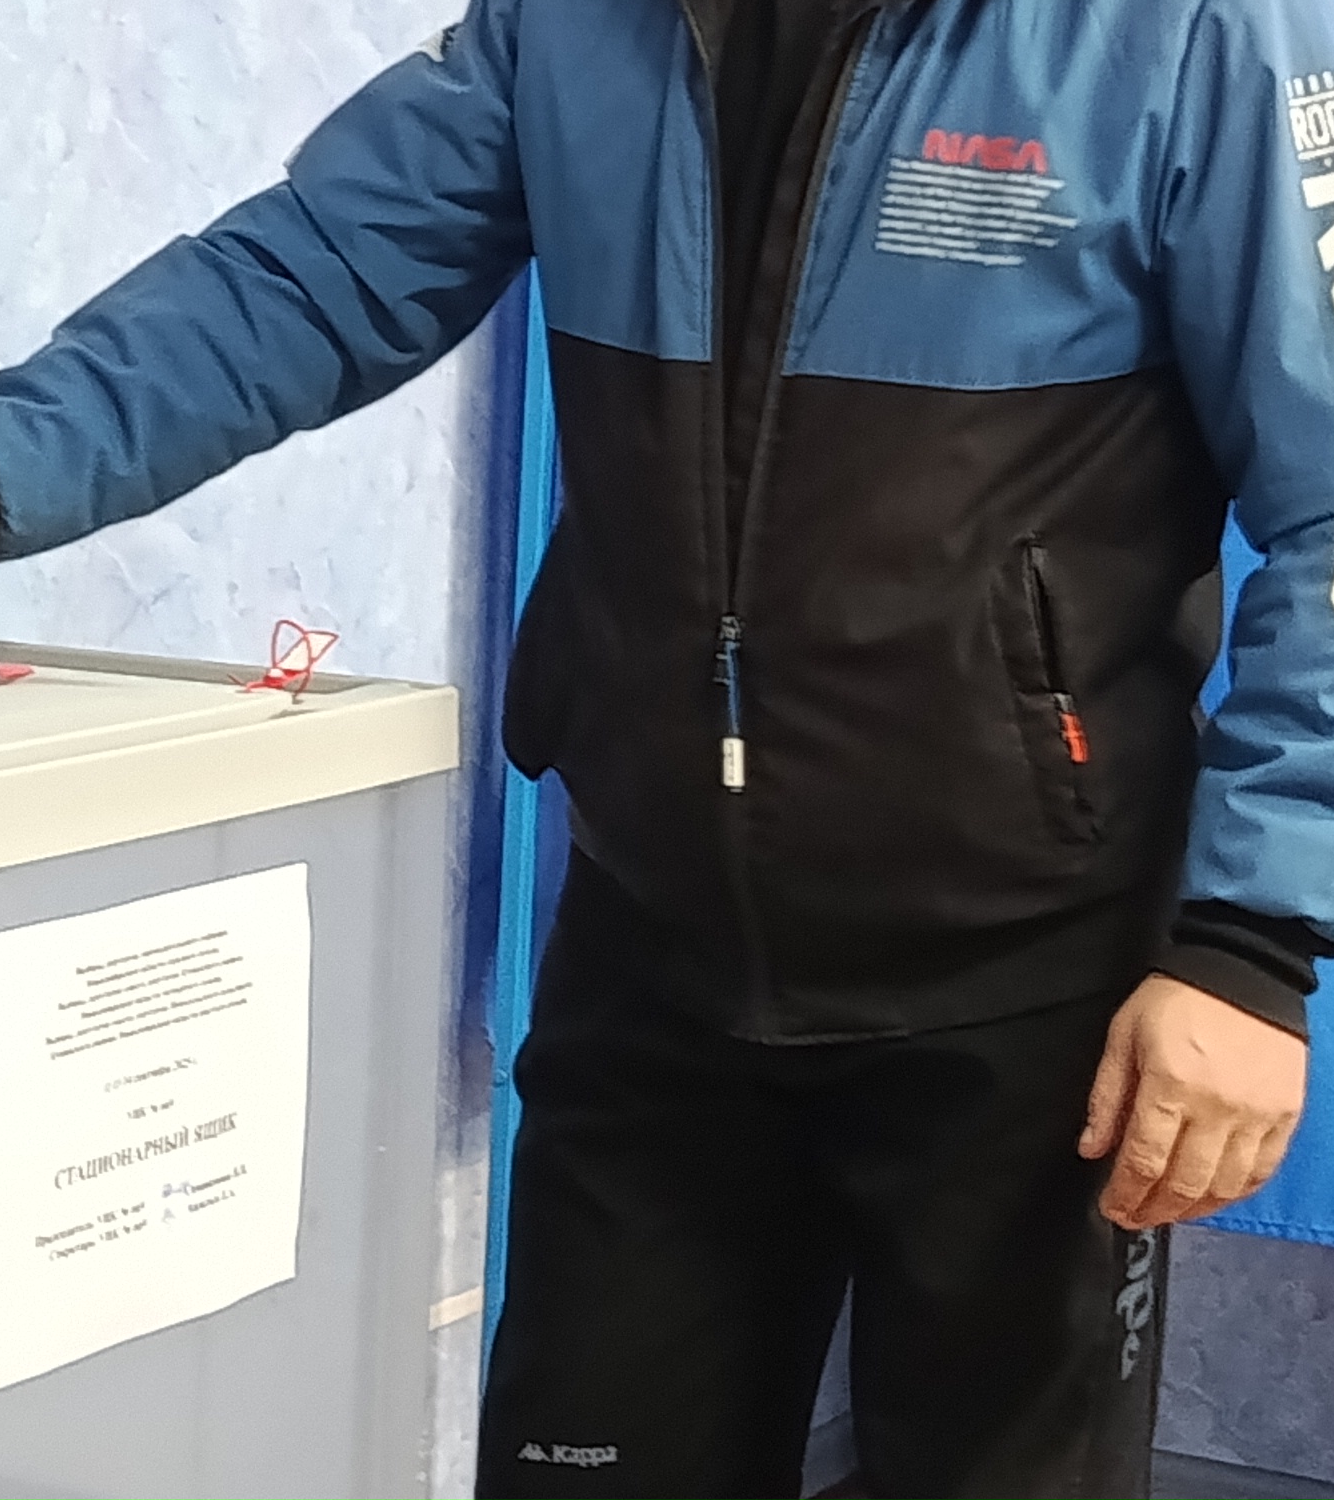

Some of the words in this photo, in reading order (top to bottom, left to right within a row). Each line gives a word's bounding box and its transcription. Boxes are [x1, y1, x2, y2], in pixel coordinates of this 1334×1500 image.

[922, 128, 1048, 174] NASA
[54, 1124, 189, 1190] СТАЦИОНАРНЫЙ
[193, 1111, 237, 1145] ЯЩИК
[552, 1444, 618, 1468] Kappa
